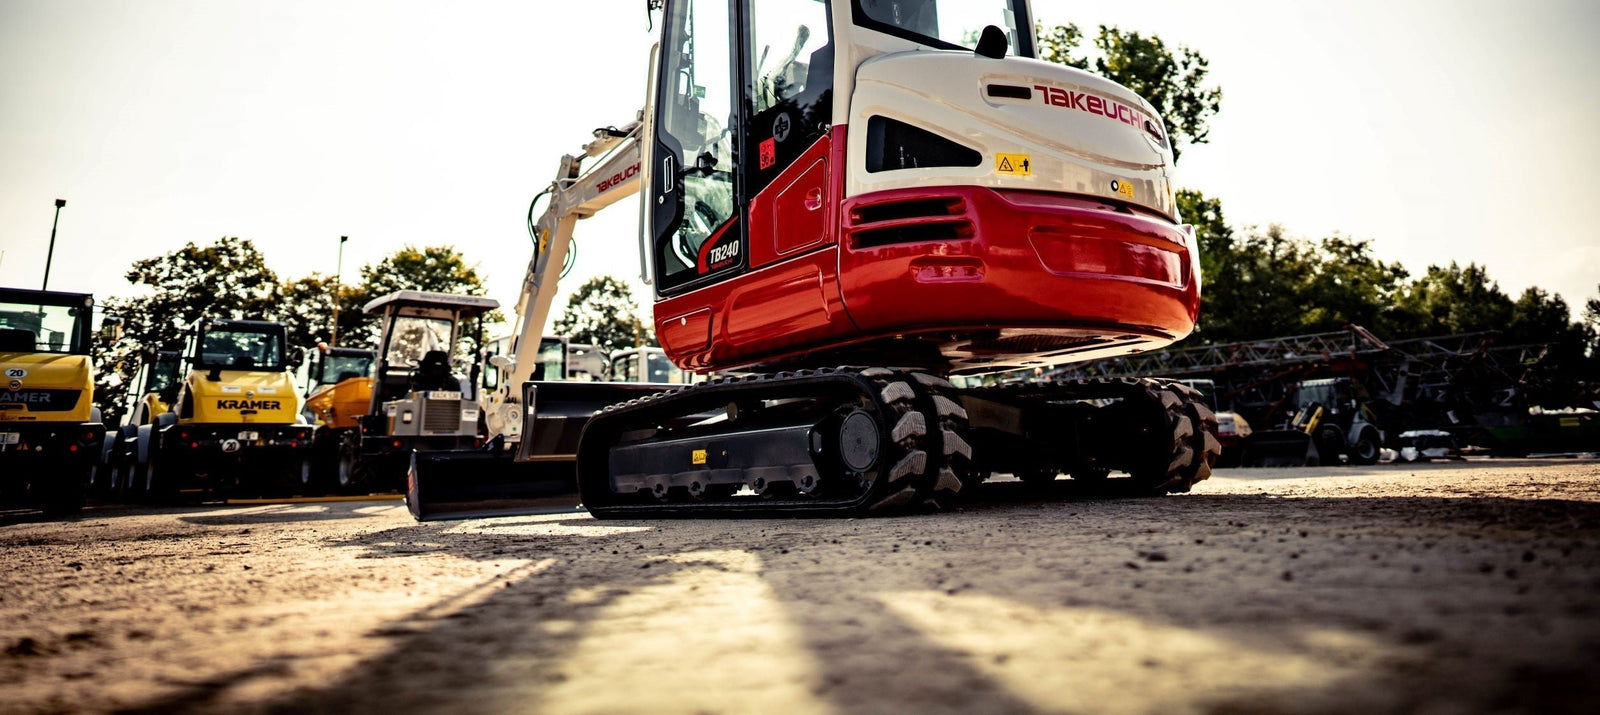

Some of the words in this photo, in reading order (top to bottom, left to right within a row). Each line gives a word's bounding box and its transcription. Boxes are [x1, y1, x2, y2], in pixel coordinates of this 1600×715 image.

[711, 240, 739, 264] TB240
[217, 400, 281, 410] KRAMER
[226, 442, 237, 451] 20
